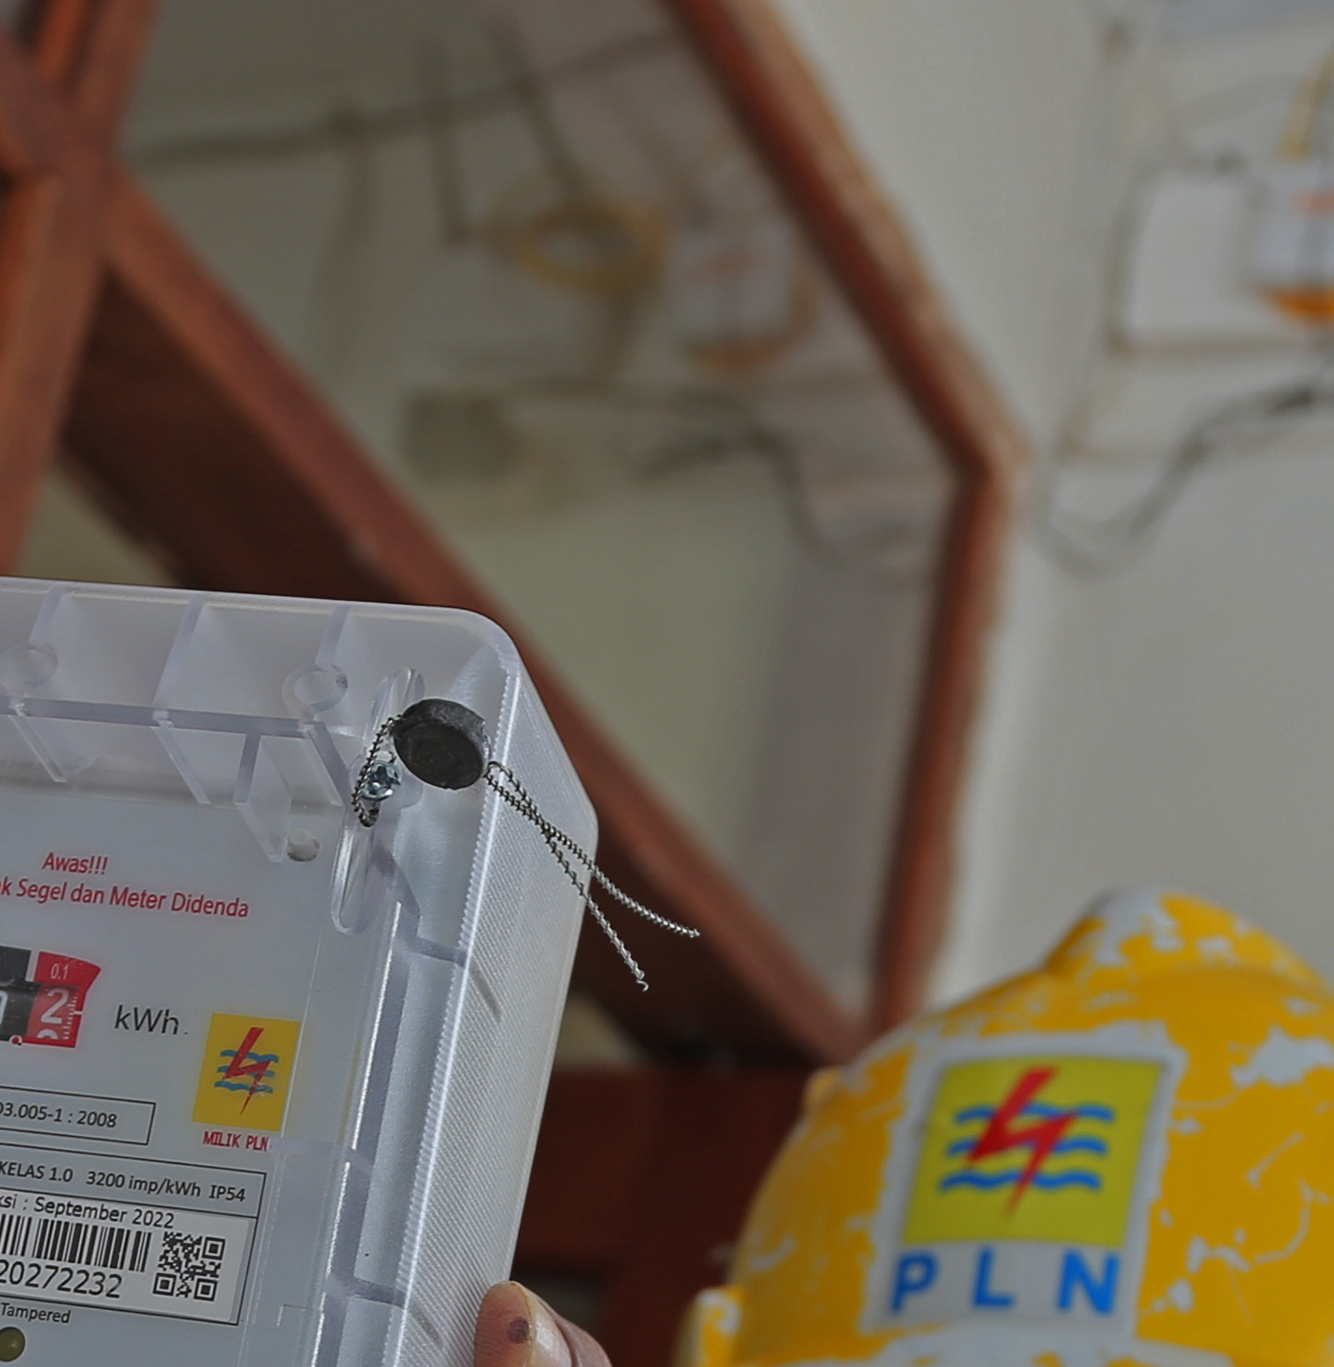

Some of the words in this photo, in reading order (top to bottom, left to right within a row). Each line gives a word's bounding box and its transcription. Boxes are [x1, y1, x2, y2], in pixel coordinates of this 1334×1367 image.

[41, 851, 108, 875] Awas!!!
[16, 878, 67, 904] Segel
[70, 883, 105, 904] dan
[108, 886, 168, 909] Meter
[171, 892, 250, 918] Didenda
[50, 963, 69, 980] 0.1
[114, 1004, 180, 1035] kWh
[76, 1110, 117, 1128] 2008
[202, 1131, 242, 1148] MILIK
[245, 1135, 270, 1151] PLN
[48, 1166, 73, 1183] 1.0
[86, 1171, 125, 1189] 3200
[128, 1174, 201, 1198] imp/kWh
[209, 1184, 246, 1203] IP54
[33, 1196, 127, 1224] September
[131, 1208, 174, 1229] 2022
[890, 1248, 1120, 1315] PLN
[0, 1302, 71, 1324] Tampered
